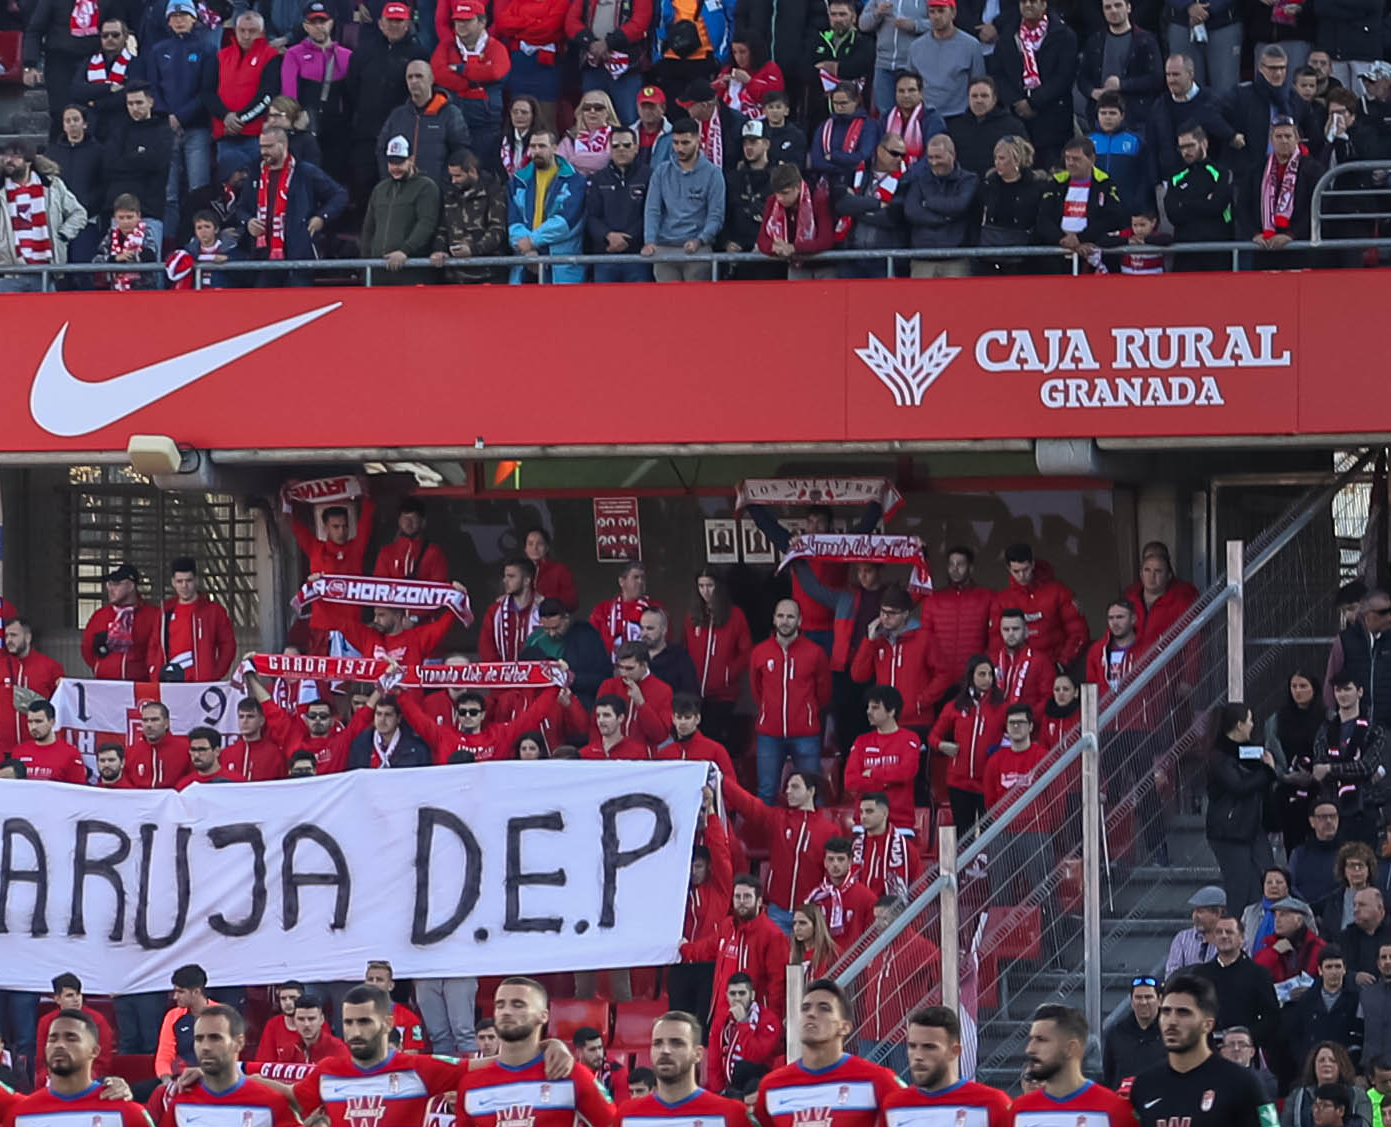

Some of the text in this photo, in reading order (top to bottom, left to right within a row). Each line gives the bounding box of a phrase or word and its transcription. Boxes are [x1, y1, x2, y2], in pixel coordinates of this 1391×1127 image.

[975, 324, 1291, 374] CAJA RURAL
[1040, 375, 1225, 408] GRANADA
[336, 659, 377, 676] 1931
